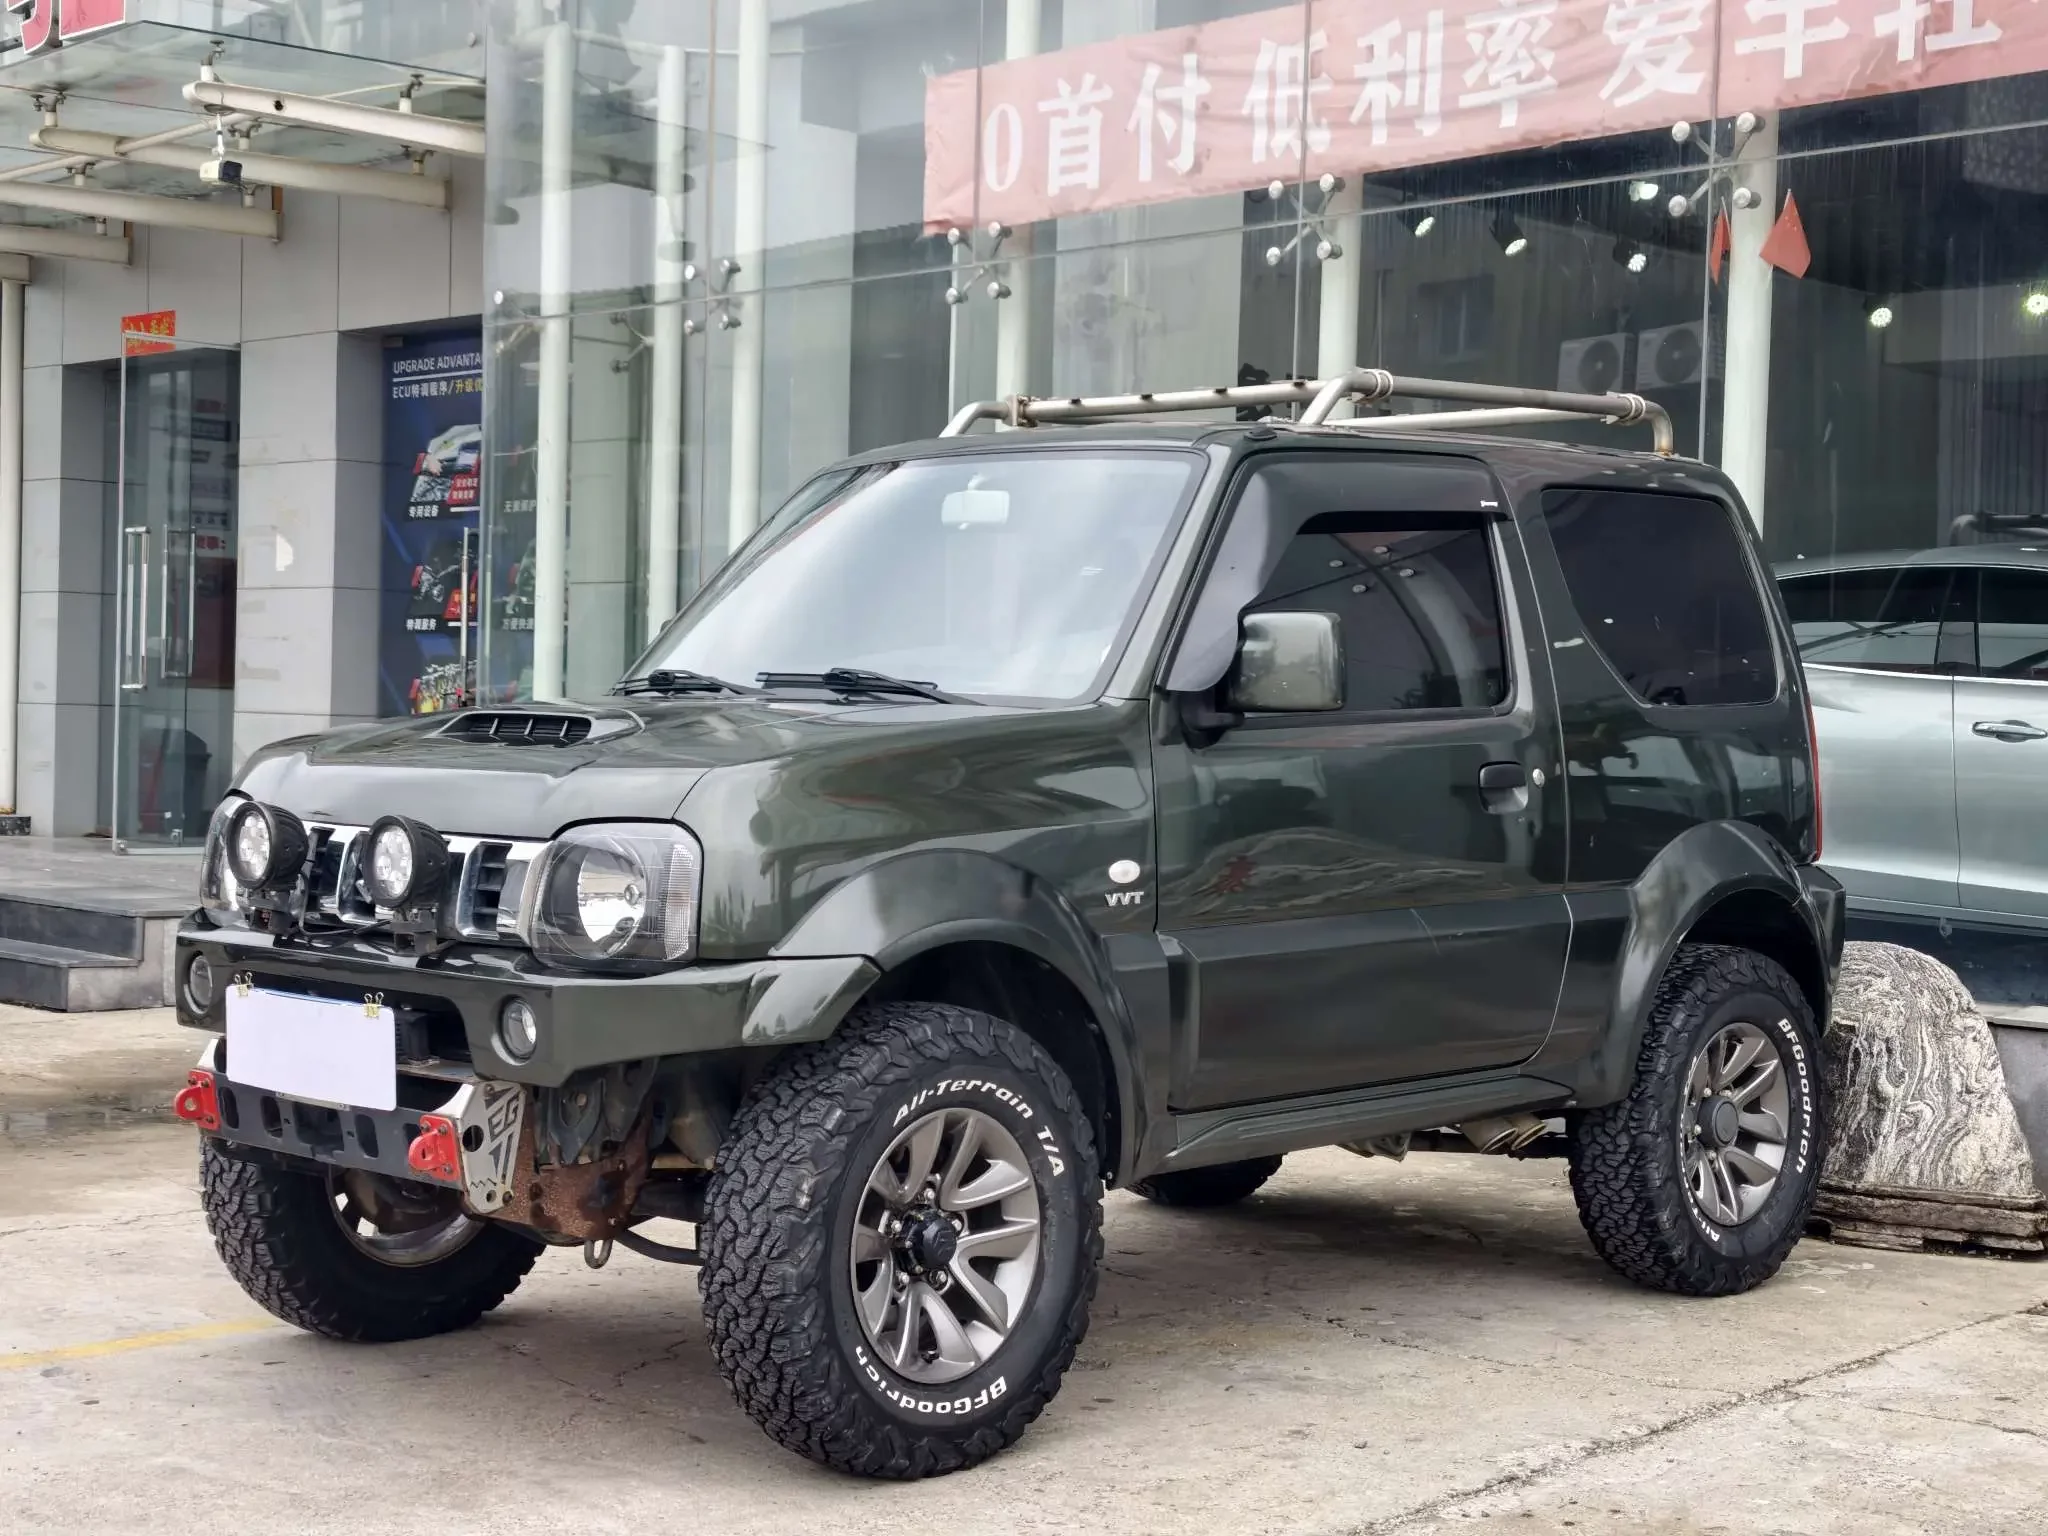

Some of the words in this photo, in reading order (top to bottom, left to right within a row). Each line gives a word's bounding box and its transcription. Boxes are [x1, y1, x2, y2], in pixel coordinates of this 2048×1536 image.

[393, 358, 435, 375] UPGRADE
[1105, 891, 1145, 907] VVT
[893, 1078, 1034, 1128] All-Terrain
[1036, 1125, 1066, 1177] T/A
[1777, 1018, 1815, 1174] BFGoodrich
[855, 1345, 1007, 1415] BFGoodrich
